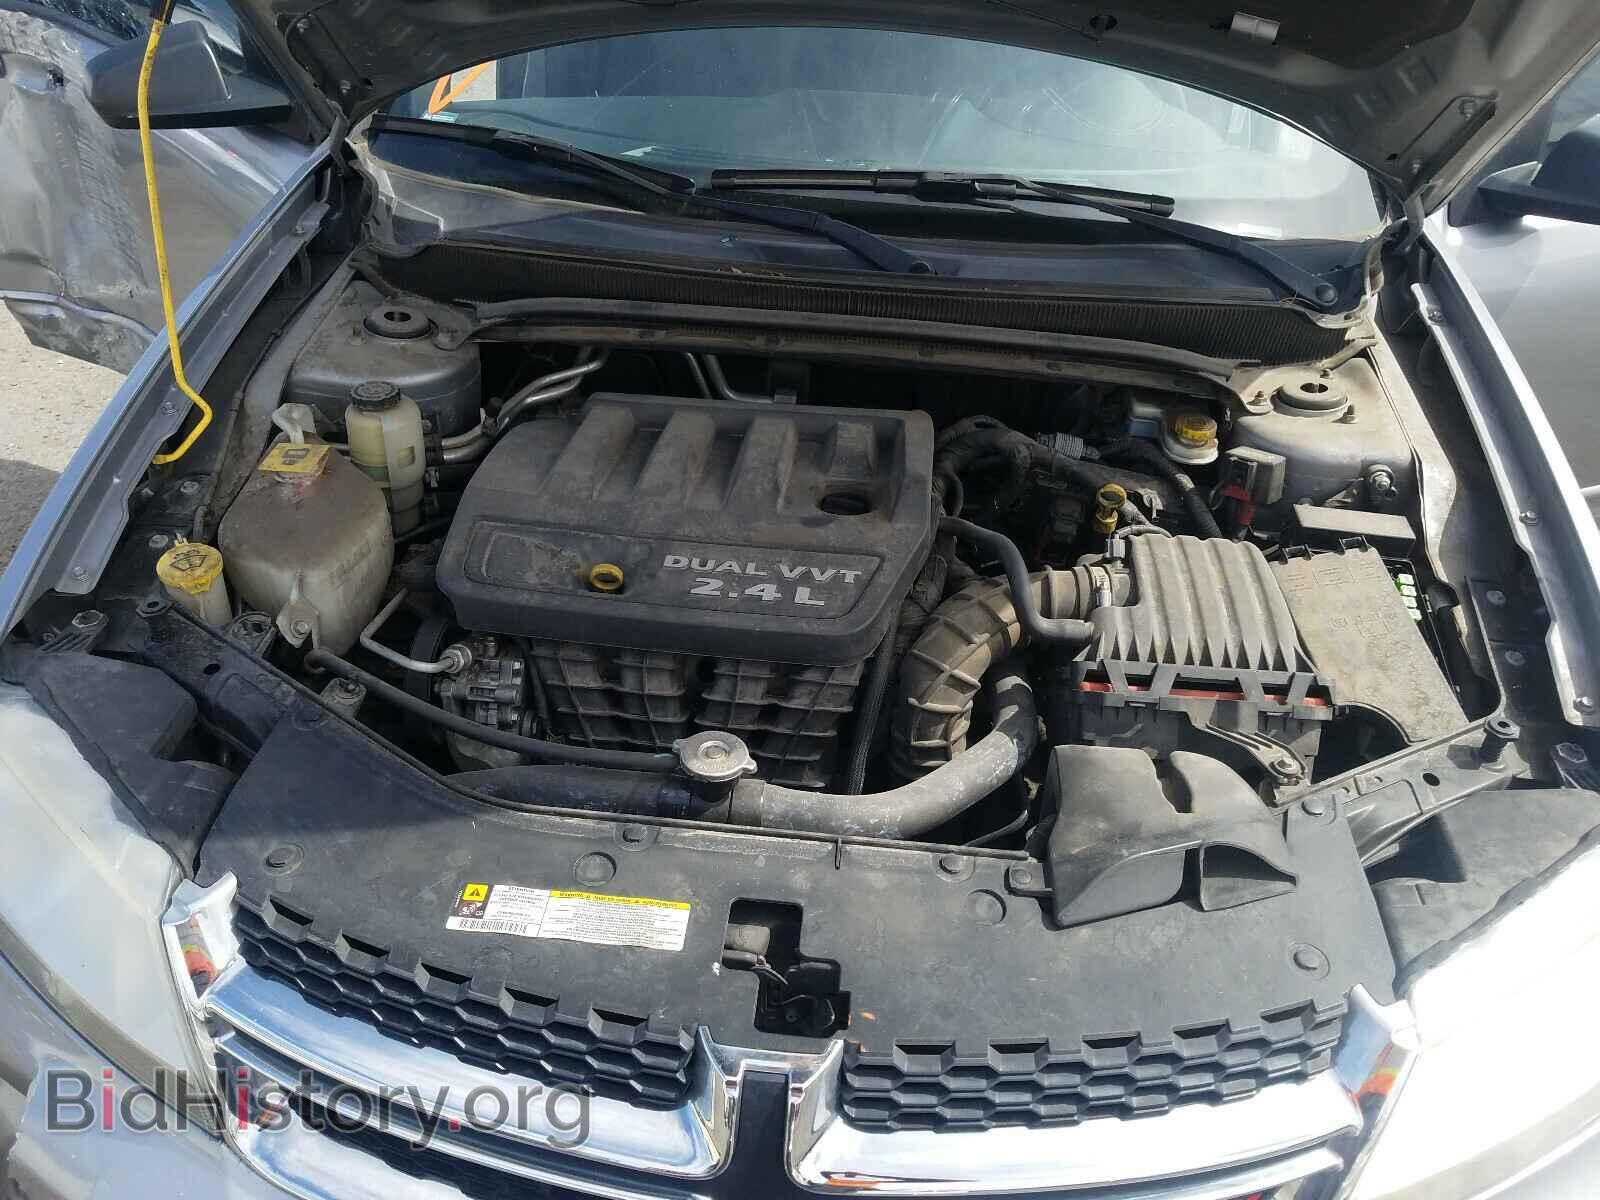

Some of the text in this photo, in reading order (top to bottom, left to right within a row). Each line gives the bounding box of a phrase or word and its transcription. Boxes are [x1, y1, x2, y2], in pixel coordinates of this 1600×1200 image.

[663, 554, 863, 584] DUAL VVT
[690, 577, 825, 606] 2.4 L
